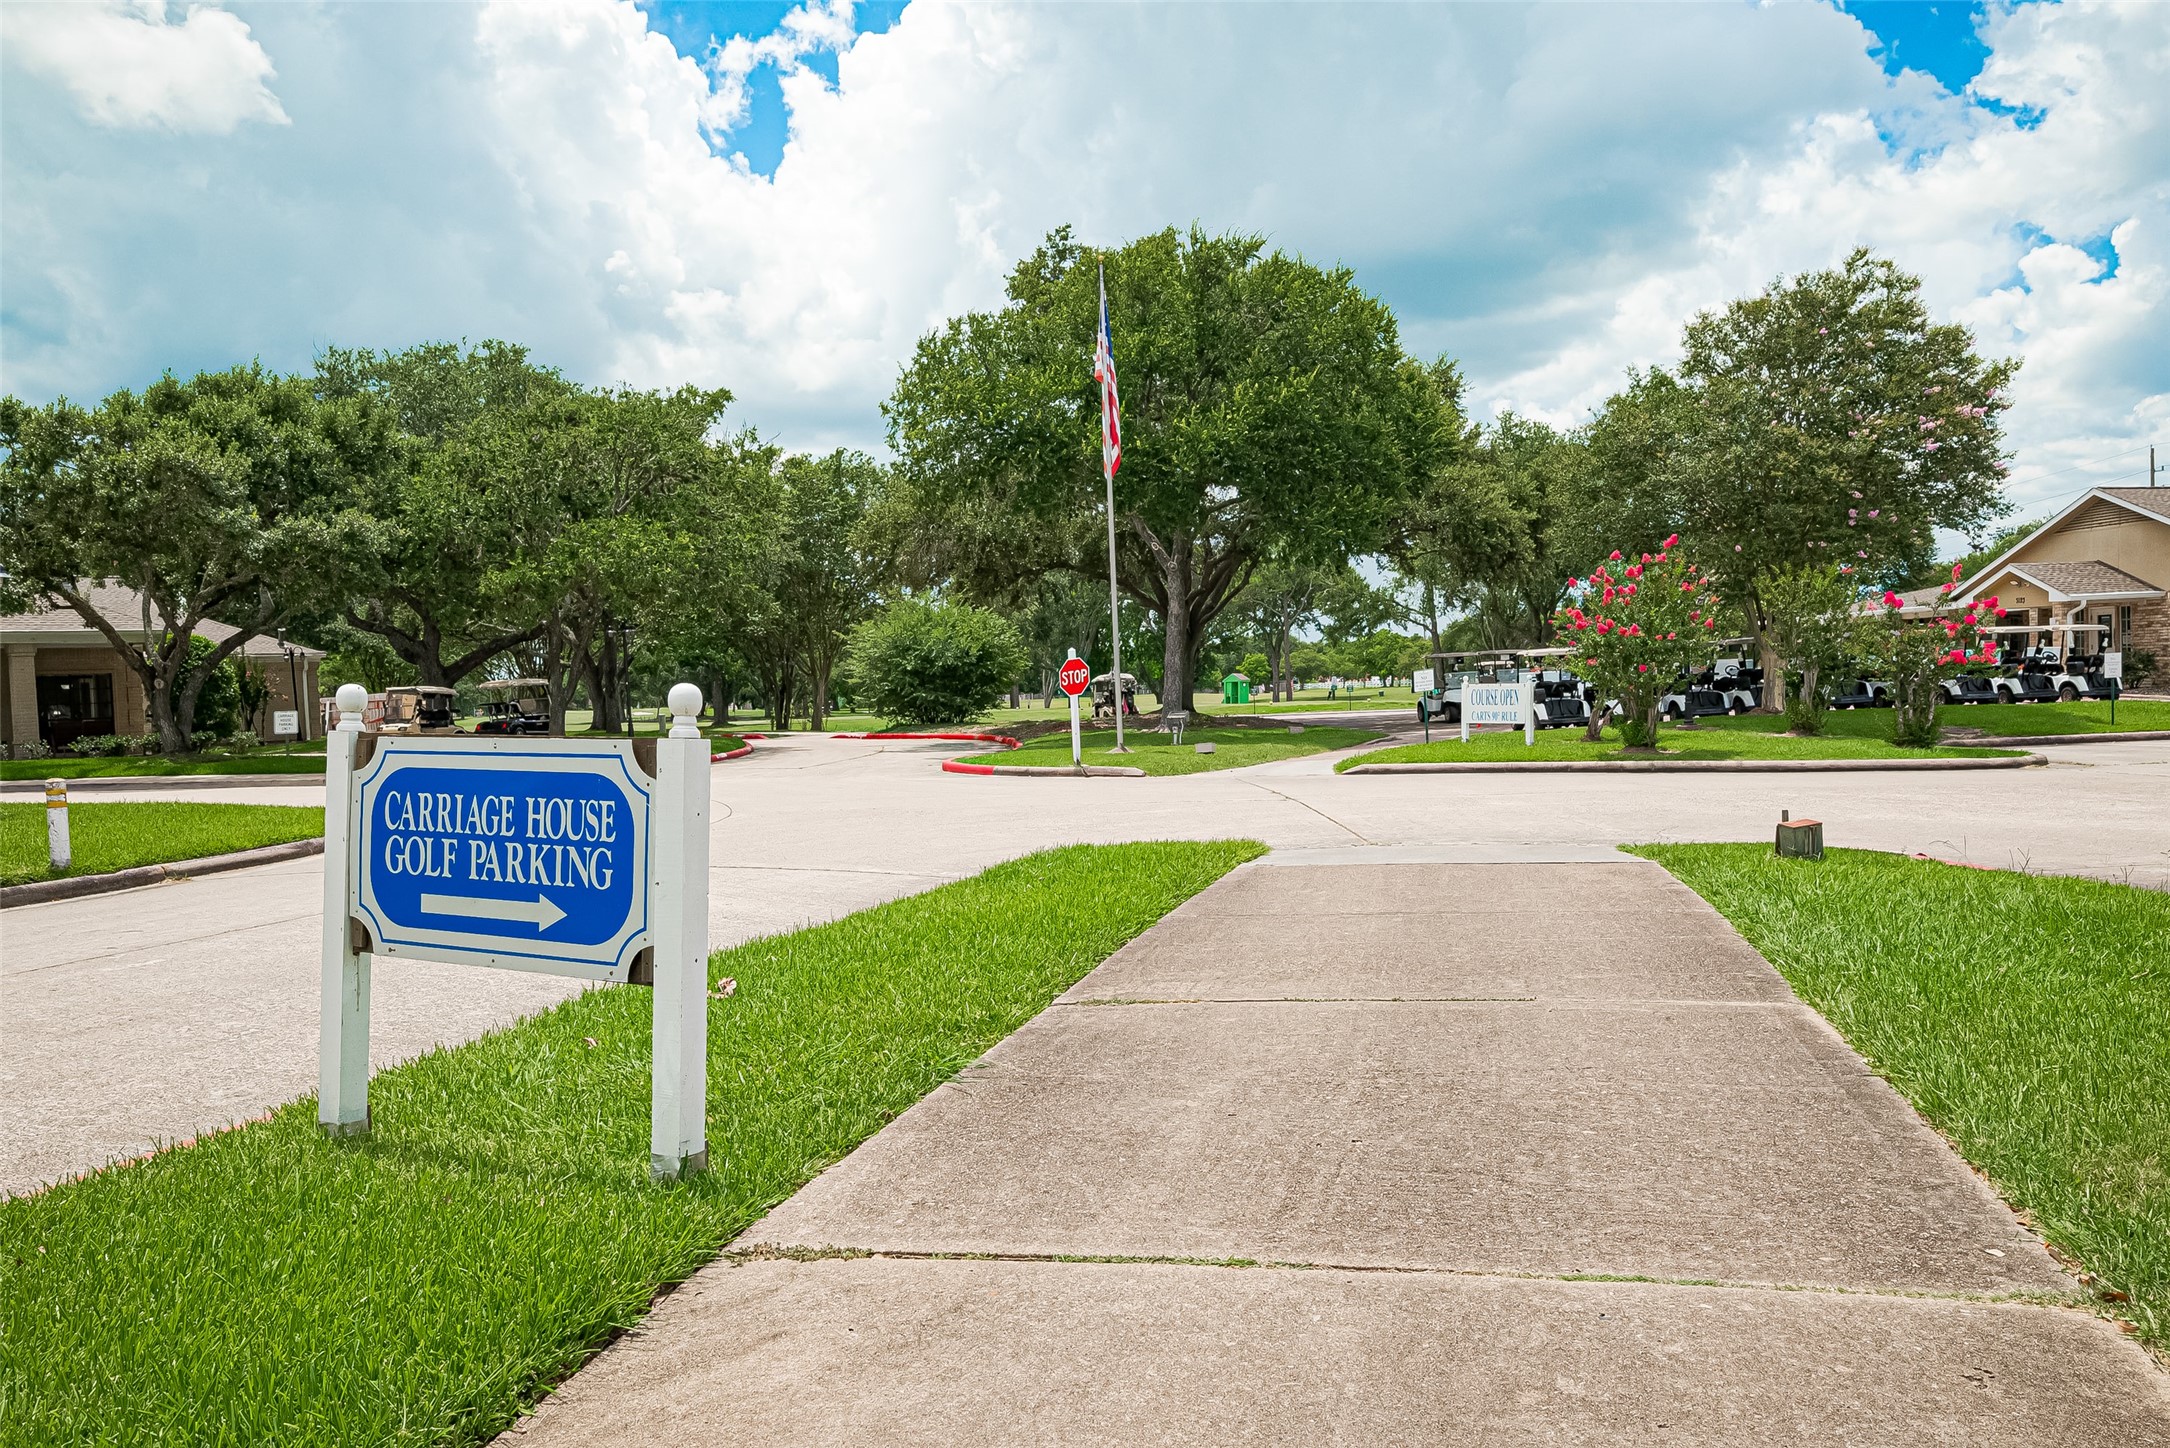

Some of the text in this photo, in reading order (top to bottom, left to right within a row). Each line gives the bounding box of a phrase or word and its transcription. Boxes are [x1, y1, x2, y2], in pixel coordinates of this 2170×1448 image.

[1062, 668, 1088, 686] STOP
[1470, 688, 1519, 706] COURSE OPEN
[1472, 710, 1490, 721] CARTS
[1501, 711, 1518, 722] RULE
[384, 790, 617, 843] CARRIAGE HOUSE
[384, 834, 614, 891] GOLF PARKING
